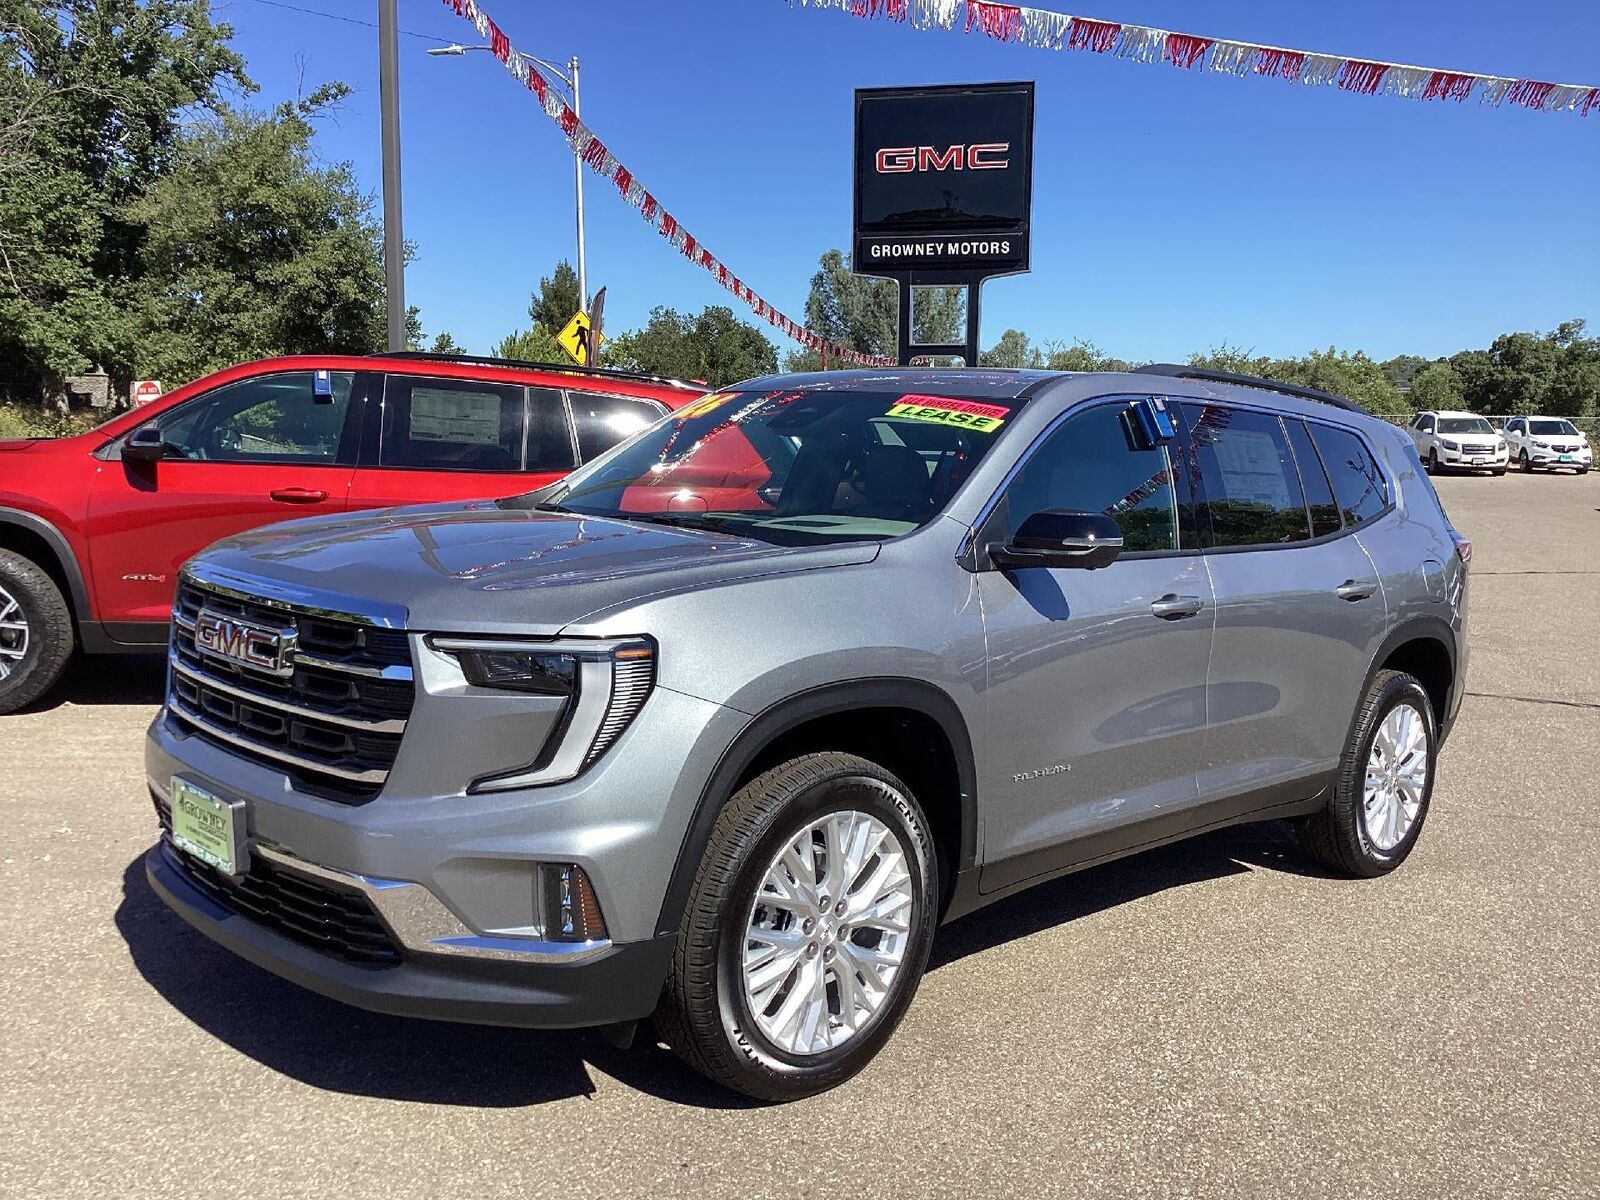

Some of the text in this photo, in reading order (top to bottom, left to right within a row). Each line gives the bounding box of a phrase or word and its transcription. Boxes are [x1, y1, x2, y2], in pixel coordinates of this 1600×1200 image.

[875, 142, 1010, 174] GMC
[871, 241, 1010, 257] GROWNEY MOTORS
[898, 406, 994, 427] LEASE
[198, 617, 278, 669] GMC
[185, 800, 227, 831] GROWNEY
